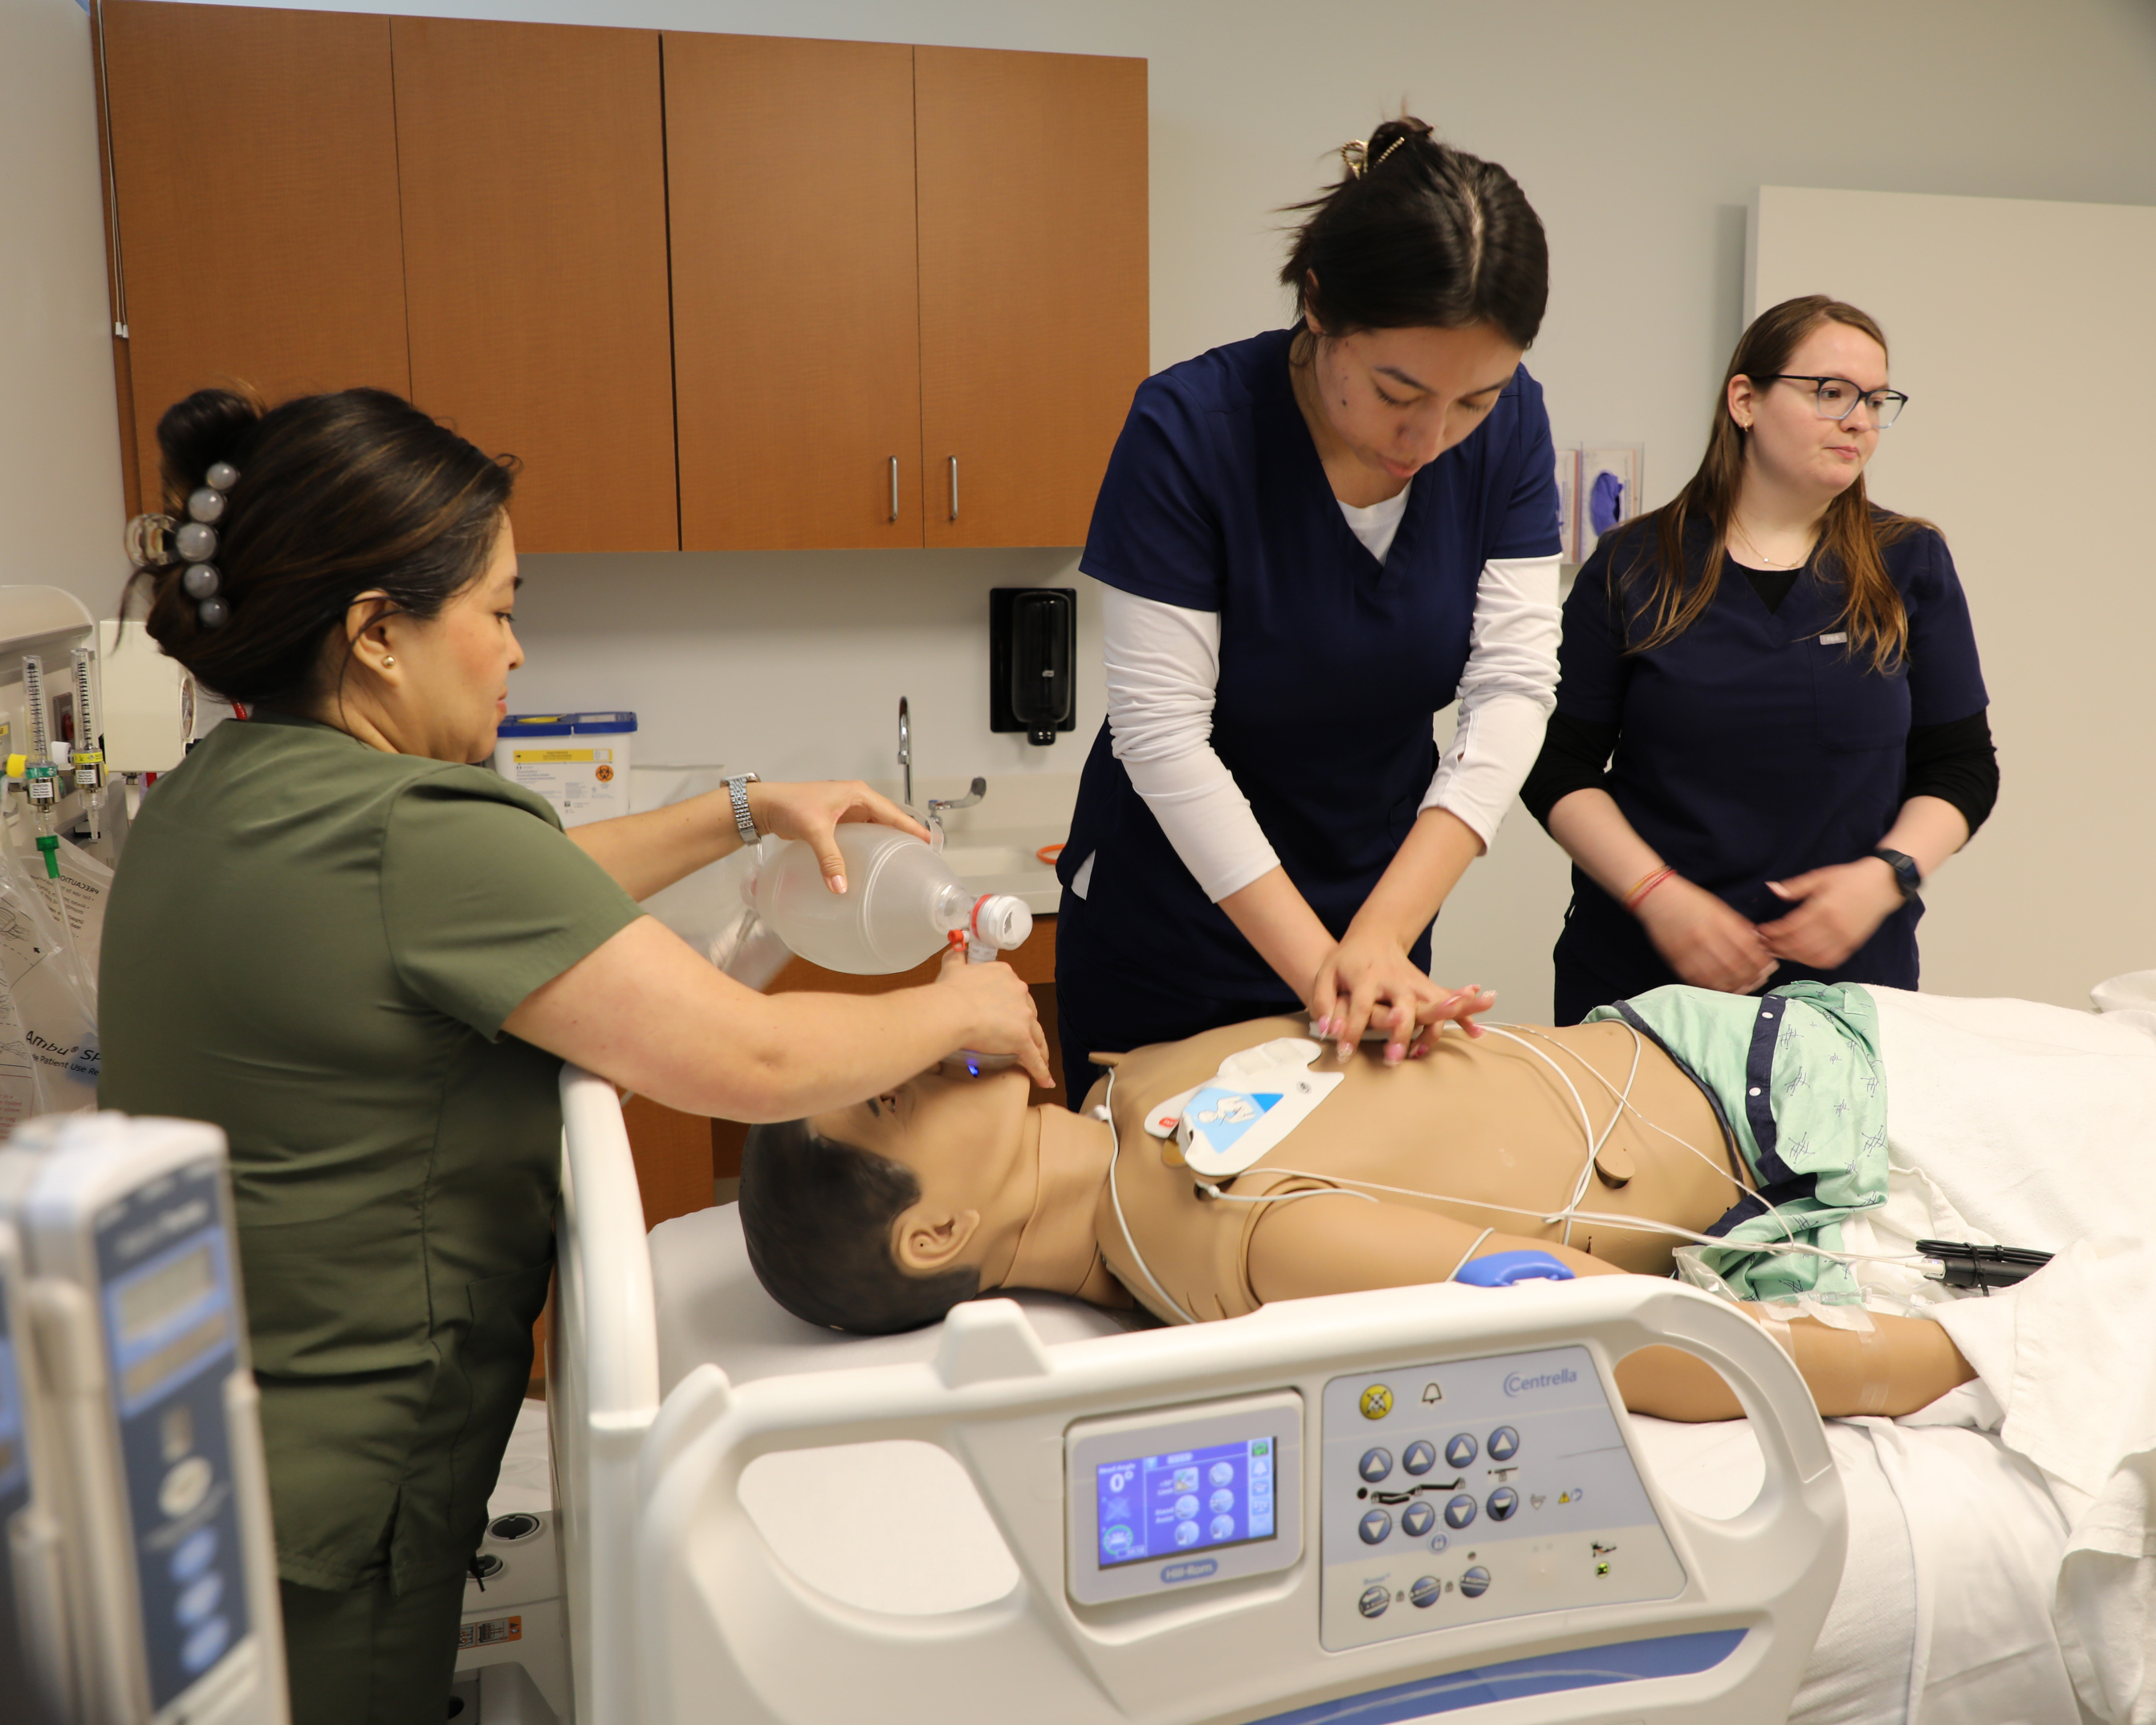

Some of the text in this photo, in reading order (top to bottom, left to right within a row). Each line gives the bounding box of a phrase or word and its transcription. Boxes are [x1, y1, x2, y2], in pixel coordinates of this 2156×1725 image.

[39, 1056, 69, 1068] Patient
[70, 1063, 87, 1072] Use
[88, 1068, 100, 1076] Re
[1505, 1368, 1577, 1397] Centrella
[1109, 1470, 1134, 1493] 0°
[1165, 1562, 1214, 1580] Hill-Rom
